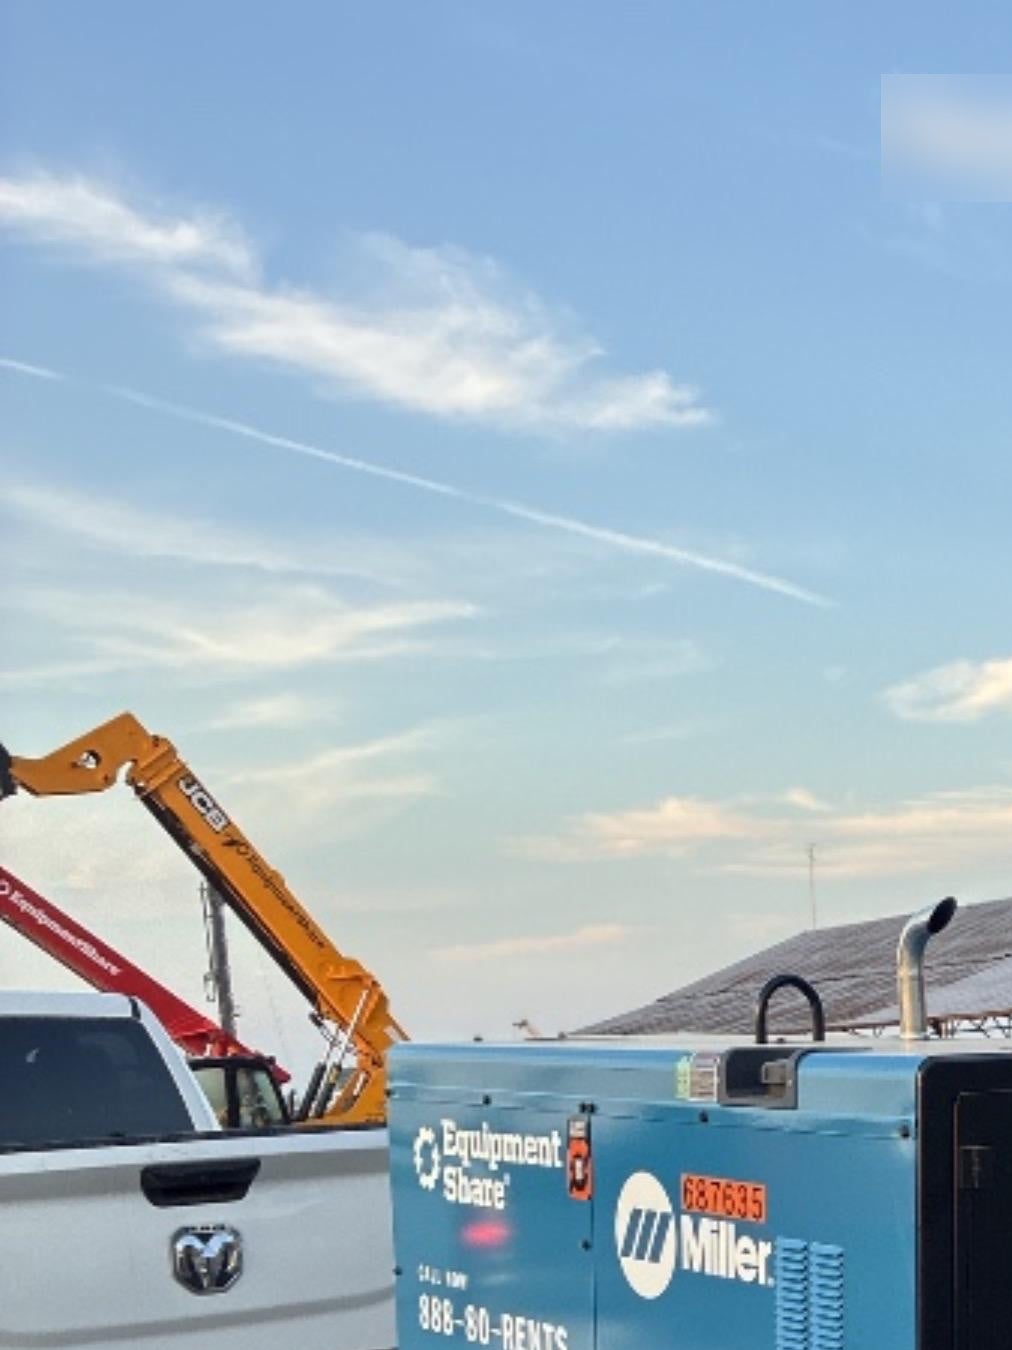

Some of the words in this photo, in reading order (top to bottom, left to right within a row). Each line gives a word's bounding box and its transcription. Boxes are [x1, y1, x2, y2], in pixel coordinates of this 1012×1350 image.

[179, 774, 230, 832] JCB
[8, 890, 121, 976] EquipmentShare
[441, 1119, 563, 1168] Equipment
[442, 1165, 505, 1210] Share
[683, 1177, 763, 1221] 687635
